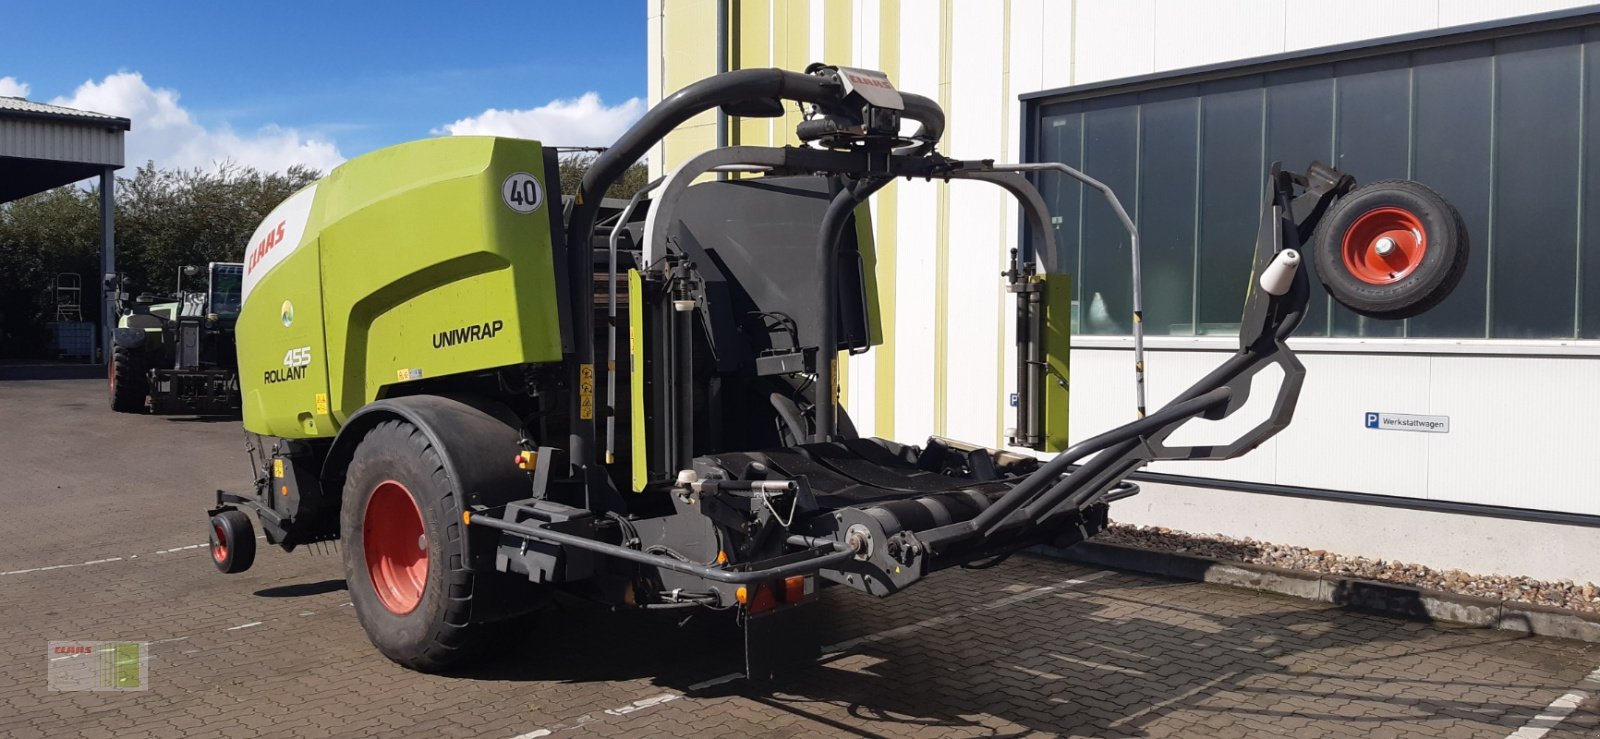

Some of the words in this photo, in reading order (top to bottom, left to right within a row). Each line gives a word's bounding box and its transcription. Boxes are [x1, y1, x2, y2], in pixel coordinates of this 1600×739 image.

[848, 75, 891, 89] CLAAS
[510, 180, 537, 206] 40
[248, 220, 286, 275] CLAAS
[432, 320, 503, 349] UNIWRAP
[283, 346, 311, 367] 455
[264, 365, 307, 384] ROLLANT
[1367, 414, 1377, 427] P
[1383, 417, 1444, 429] Werkstattwagen
